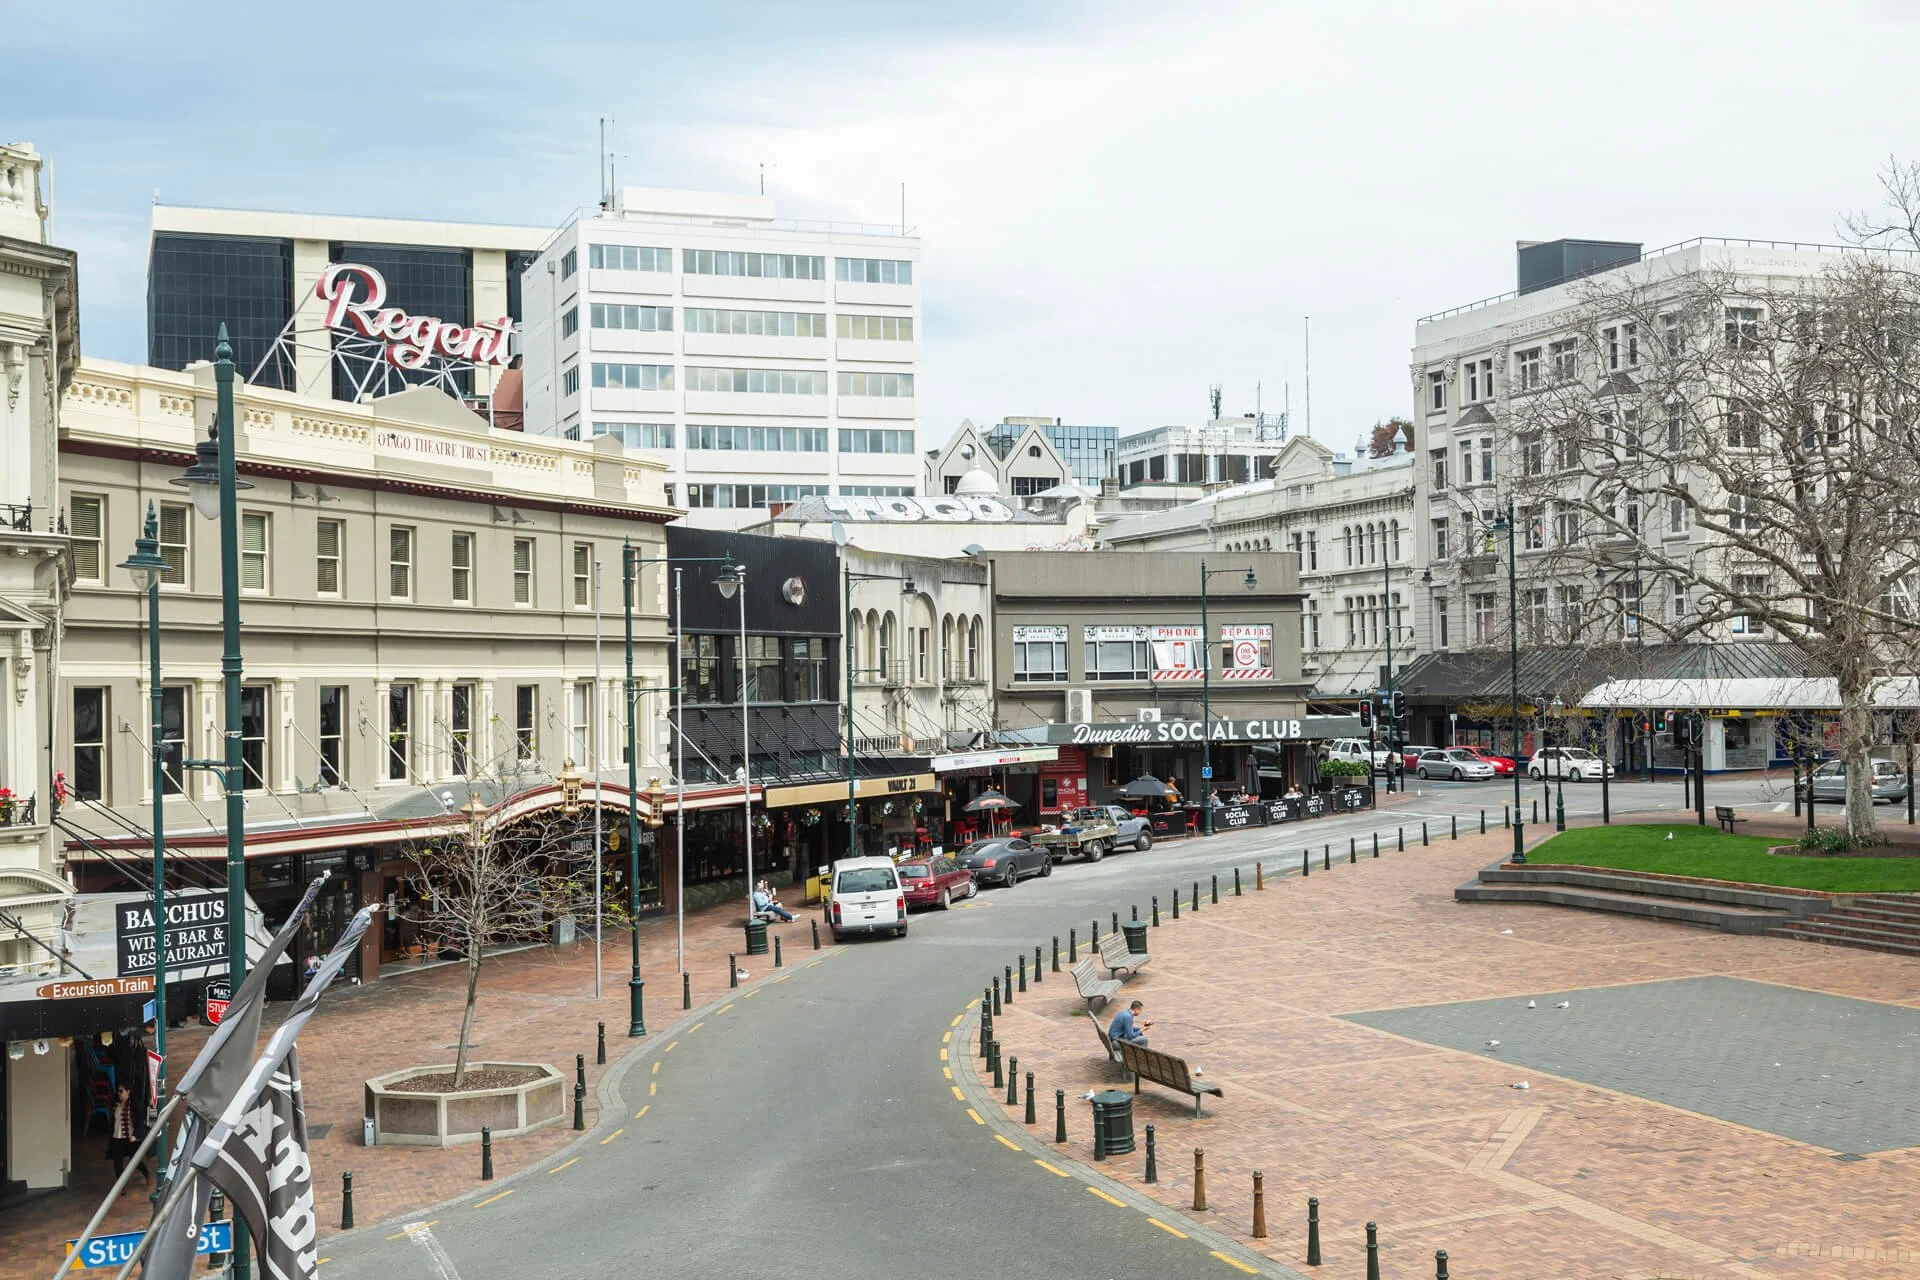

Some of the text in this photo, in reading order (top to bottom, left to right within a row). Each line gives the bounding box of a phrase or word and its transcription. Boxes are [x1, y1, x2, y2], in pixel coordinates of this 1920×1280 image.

[316, 262, 518, 369] Regent
[377, 432, 489, 462] OTAGO THEATRE TRUST
[1158, 628, 1271, 637] PHONE REPAIRS
[1072, 720, 1301, 744] Dunedin SOCIAL CLUB
[888, 778, 916, 792] VAULT 21
[1225, 810, 1250, 819] SOCIAL
[1270, 804, 1289, 813] SOCIAL
[1273, 811, 1286, 819] CLUB
[179, 929, 208, 946] BAR
[213, 927, 224, 940] &
[127, 942, 226, 969] RESAURANT
[53, 978, 149, 997] Excursion Train
[197, 1226, 220, 1251] St
